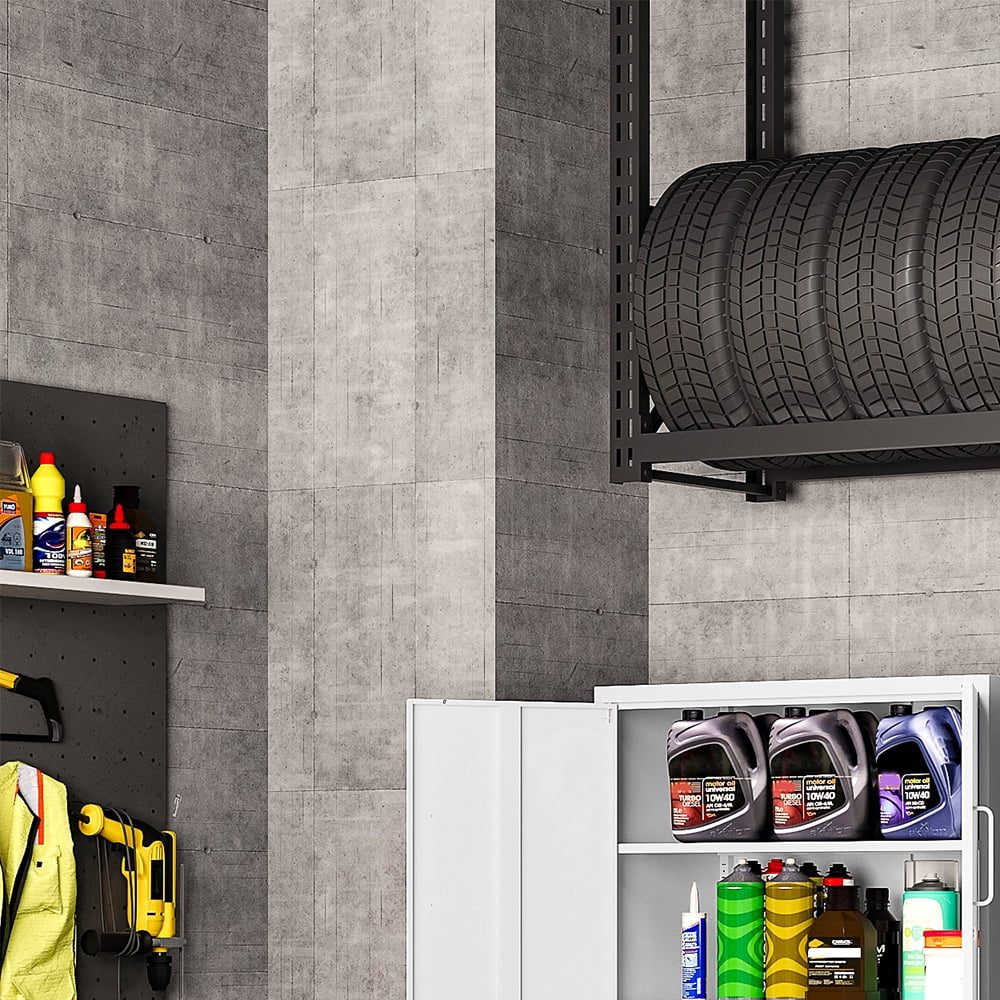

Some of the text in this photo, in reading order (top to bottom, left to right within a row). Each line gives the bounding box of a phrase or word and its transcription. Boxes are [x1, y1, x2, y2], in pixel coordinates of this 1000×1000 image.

[705, 793, 736, 802] 10W40
[806, 792, 836, 801] 10W40
[905, 791, 931, 800] 10W40
